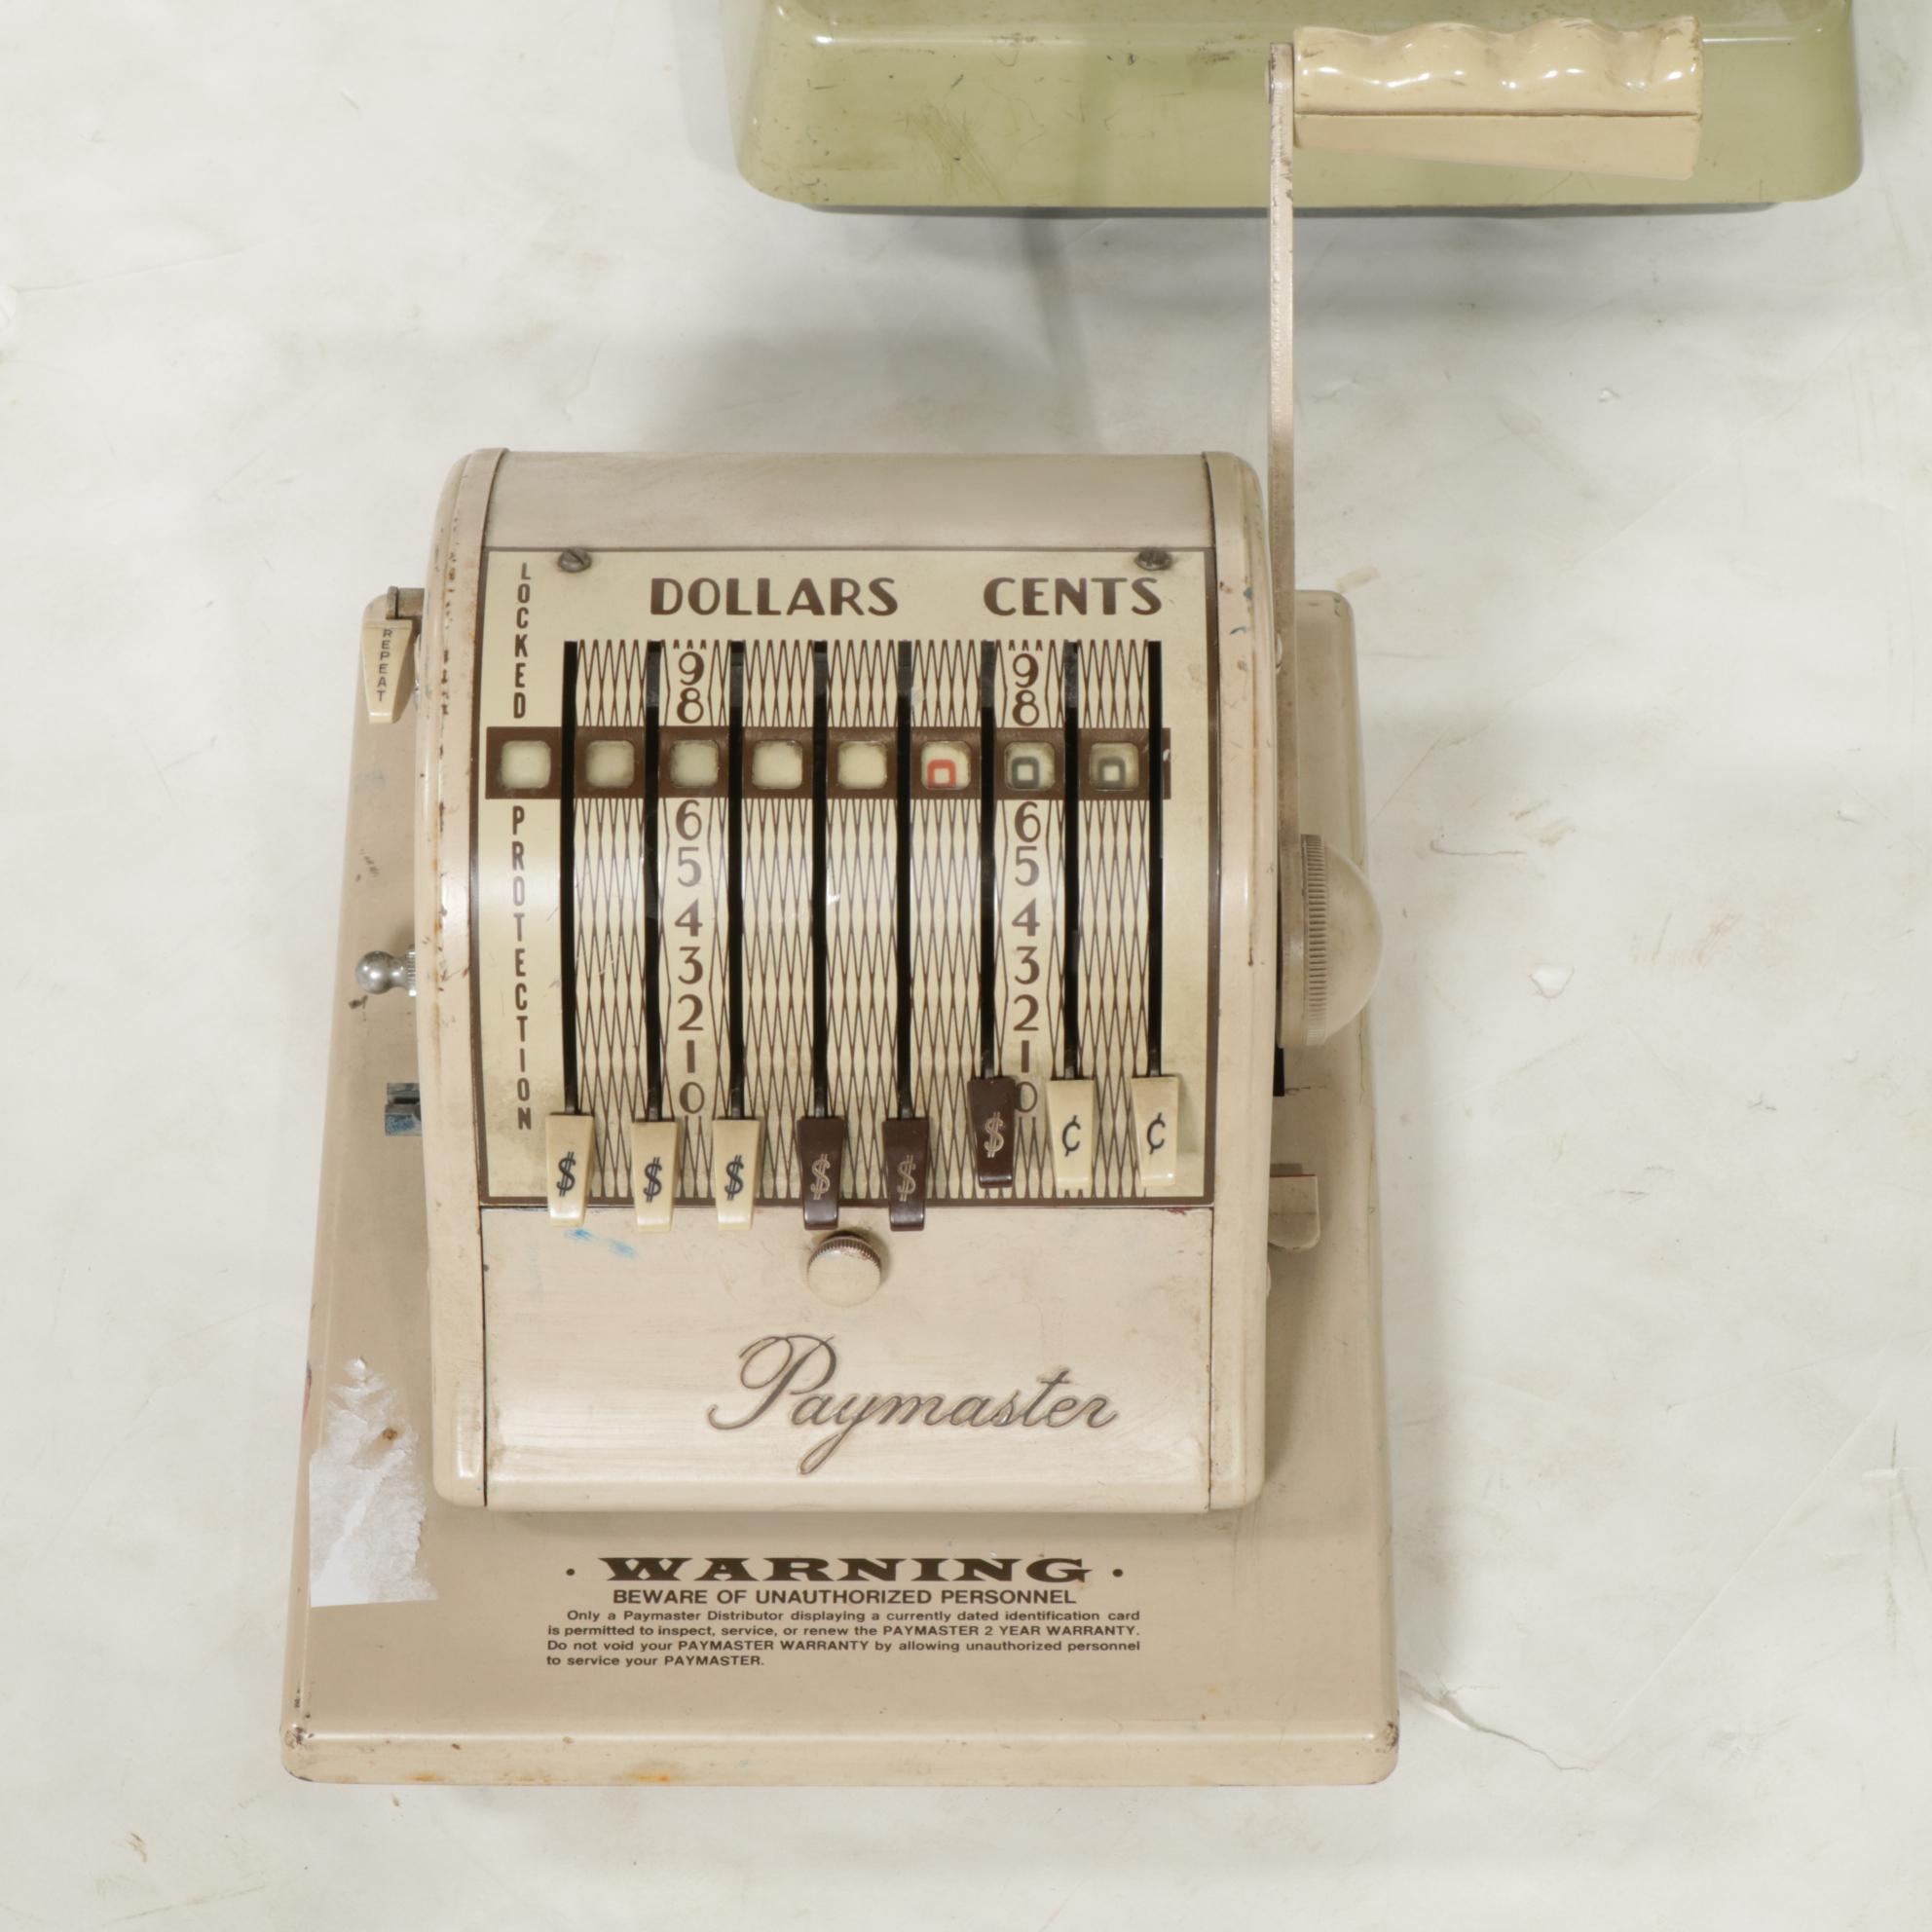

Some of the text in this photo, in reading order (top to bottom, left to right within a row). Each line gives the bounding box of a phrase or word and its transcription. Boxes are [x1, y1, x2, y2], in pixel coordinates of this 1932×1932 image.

[650, 576, 1163, 617] DOLLARS CENTS
[513, 562, 532, 720] LOCKED
[376, 628, 393, 702] REPEAT
[677, 651, 705, 687] 9
[1012, 653, 1039, 688] 9
[676, 687, 704, 724] 8
[1011, 689, 1040, 727] 8
[675, 799, 702, 841] 6
[1014, 800, 1041, 843] 6
[677, 846, 702, 888] 5
[1015, 845, 1040, 887] 5
[674, 898, 703, 937] 4
[1011, 897, 1041, 937] 4
[511, 805, 533, 1131] PROTECTION
[677, 947, 704, 985] 3
[1014, 947, 1041, 985] 3
[677, 994, 704, 1031] 2
[1013, 994, 1040, 1031] 2
[984, 1110, 1004, 1159] $
[1060, 1114, 1081, 1157] ¢
[1146, 1113, 1167, 1156] ¢
[556, 1150, 576, 1198] $
[644, 1155, 663, 1203] $
[724, 1153, 745, 1201] $
[810, 1153, 831, 1202] $
[897, 1153, 916, 1203] $
[708, 1333, 1119, 1475] Paymaster
[598, 1556, 1093, 1583] WARNING
[567, 1610, 1140, 1623] Only a Paymaster Distributor displaying a currently dated identification card
[613, 1589, 1077, 1605] BEWARE OF UNAUTHORIZED PERSONNEL
[547, 1624, 1139, 1638] is permitted to inspect, service, or renew the PAYMASTER 2 YEAR WARRANTY.
[547, 1640, 1140, 1653] Do not void your PAYMASTER WARRANTY by allowing unauthorized personnel
[545, 1654, 764, 1668] to service your PAYMASTER.
